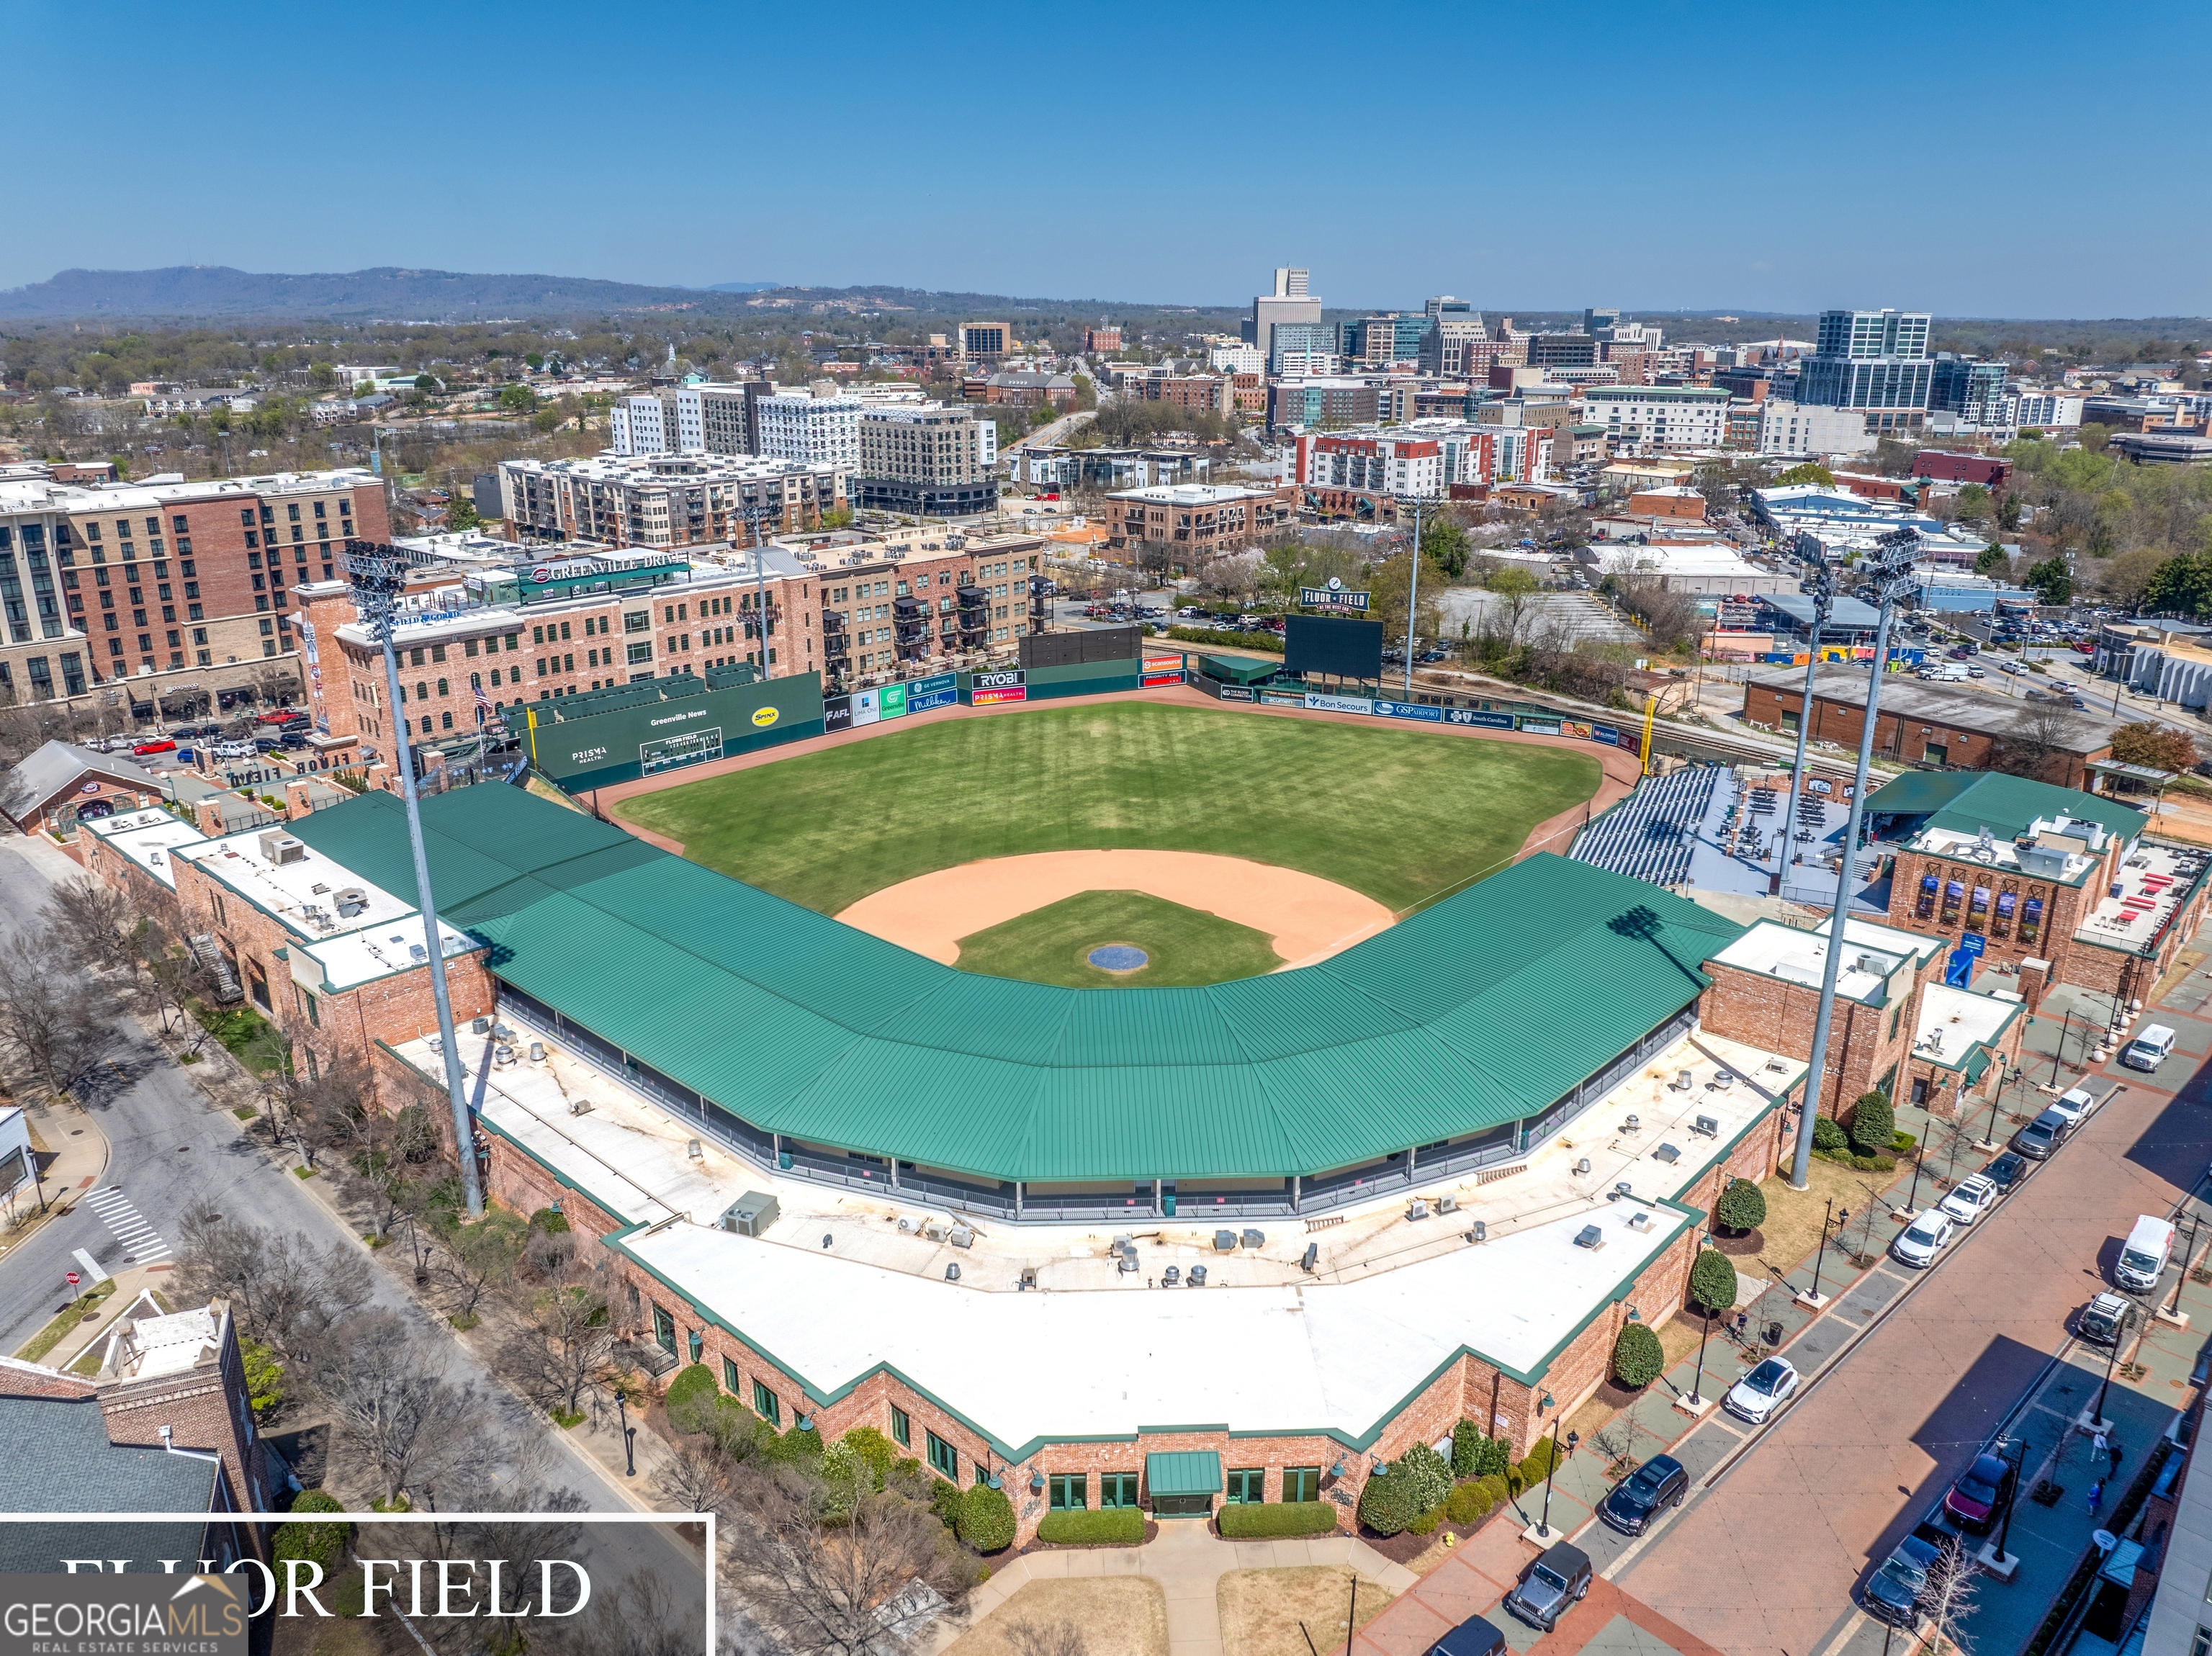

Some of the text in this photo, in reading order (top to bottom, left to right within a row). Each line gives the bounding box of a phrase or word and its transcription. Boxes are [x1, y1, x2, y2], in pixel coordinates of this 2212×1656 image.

[551, 552, 683, 580] GREENVILLE DRIVE
[1305, 591, 1364, 606] FLUOR FIELD
[390, 616, 419, 626] SFIELD
[430, 611, 462, 621] GORRIE
[930, 679, 950, 688] VERNOVA
[980, 672, 1018, 686] RYOBI
[974, 692, 1004, 701] PRISMA
[882, 703, 904, 711] Greenville
[914, 695, 951, 711] Milliken
[1337, 701, 1368, 712] Secours
[832, 708, 850, 719] AFL
[1396, 705, 1414, 714] GSP
[651, 709, 706, 726] Greenville News
[1594, 729, 1617, 739] WALDROP
[572, 747, 607, 760] PRISMA
[579, 755, 604, 764] HEALTH.
